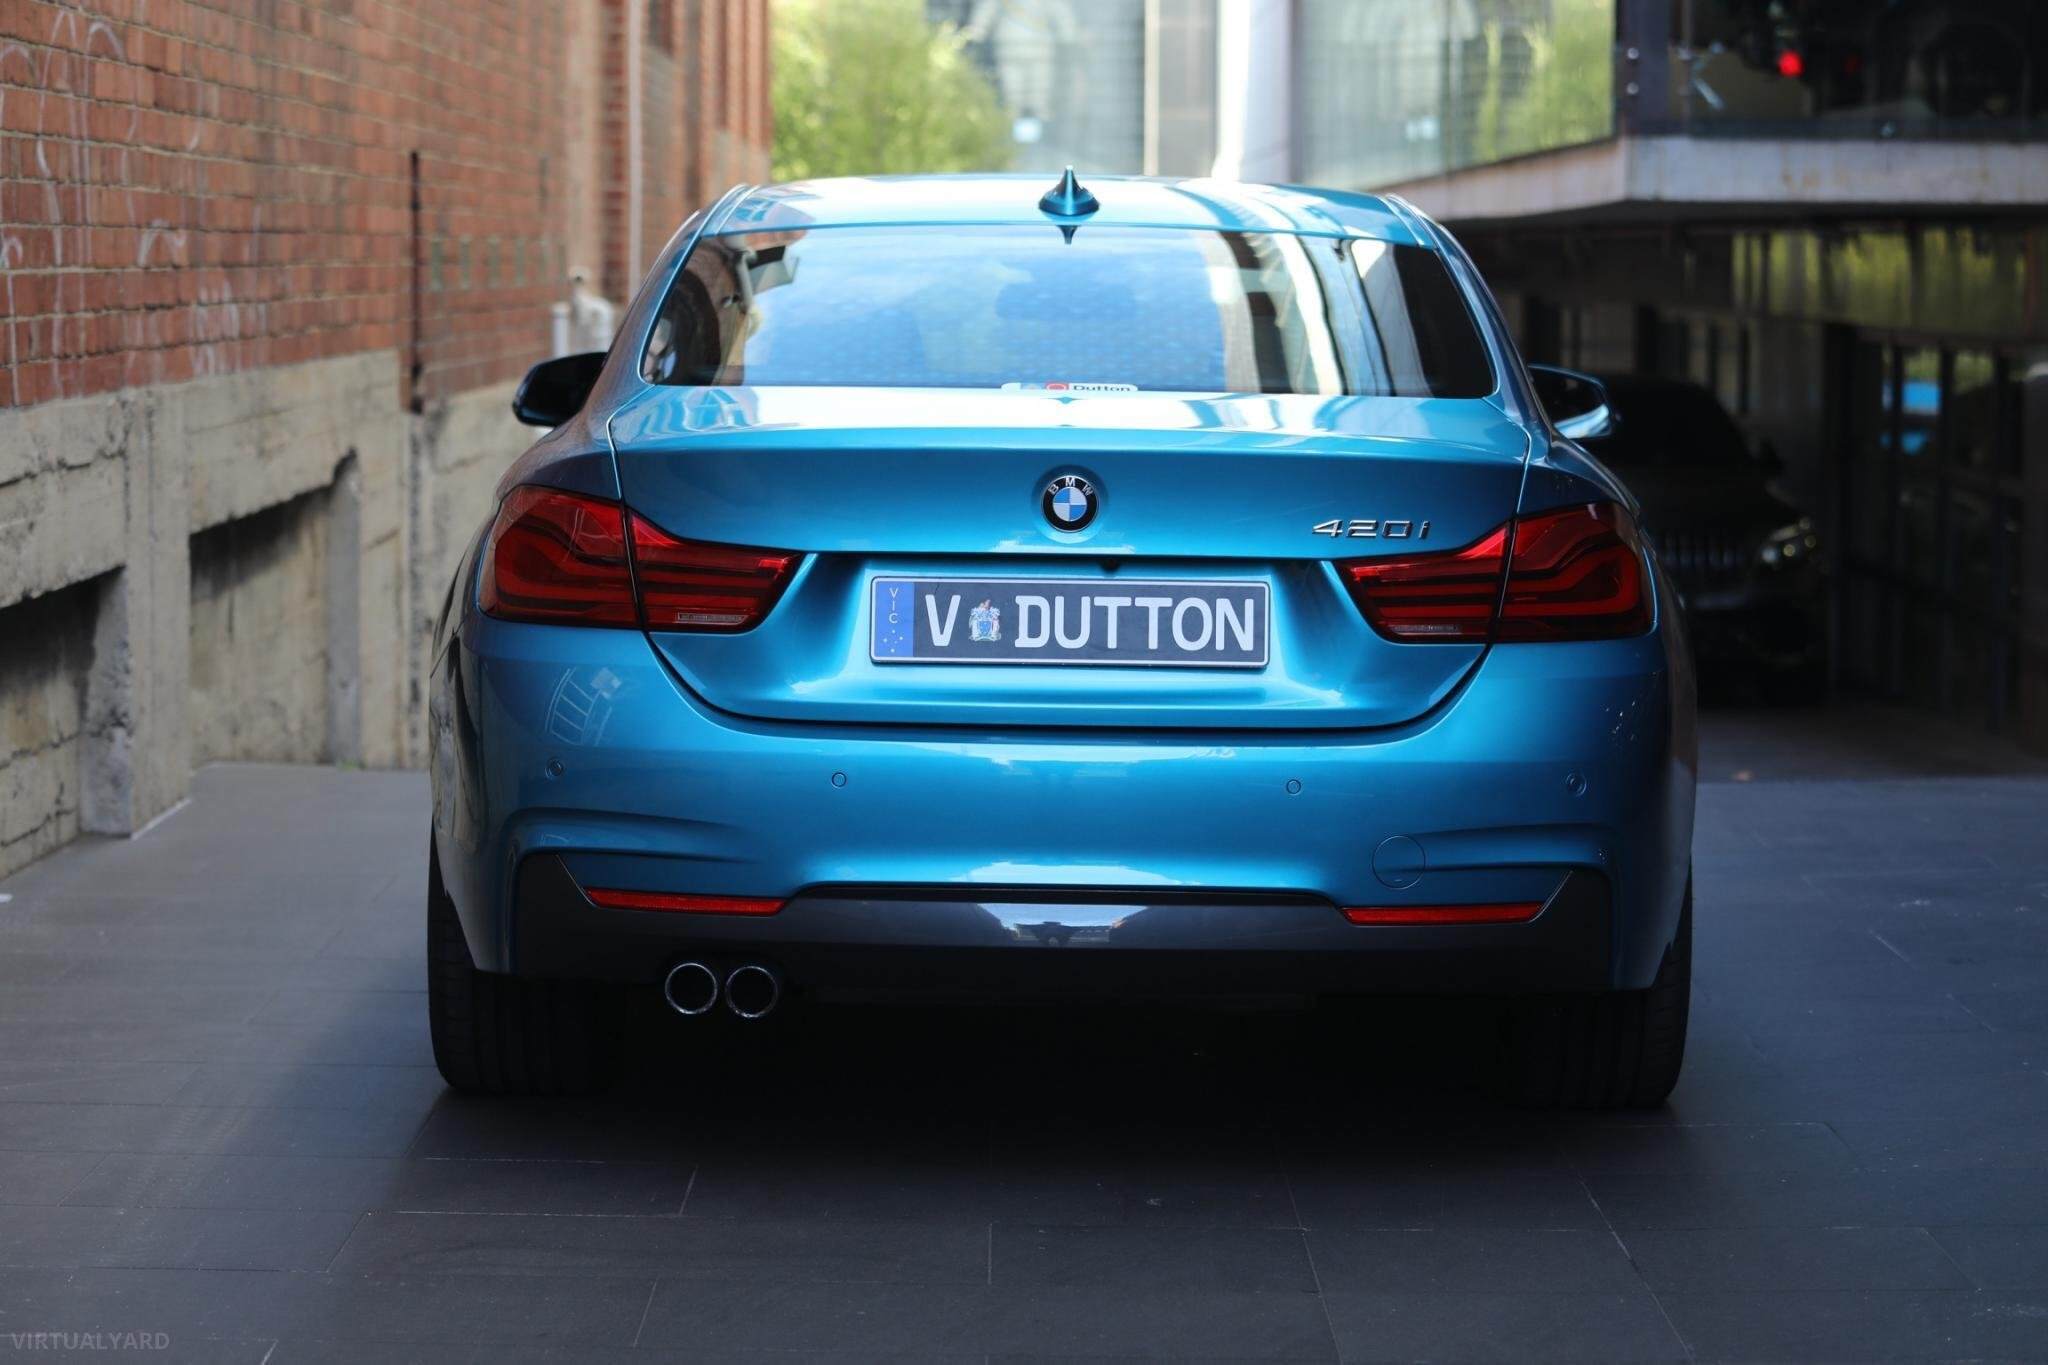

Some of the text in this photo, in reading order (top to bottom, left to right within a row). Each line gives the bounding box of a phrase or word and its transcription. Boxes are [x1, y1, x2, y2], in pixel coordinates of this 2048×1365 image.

[1073, 384, 1131, 392] Dutton
[1047, 477, 1094, 496] BMW
[1312, 519, 1430, 539] 420i
[889, 588, 900, 624] VIC
[925, 594, 1254, 652] V DUTTON
